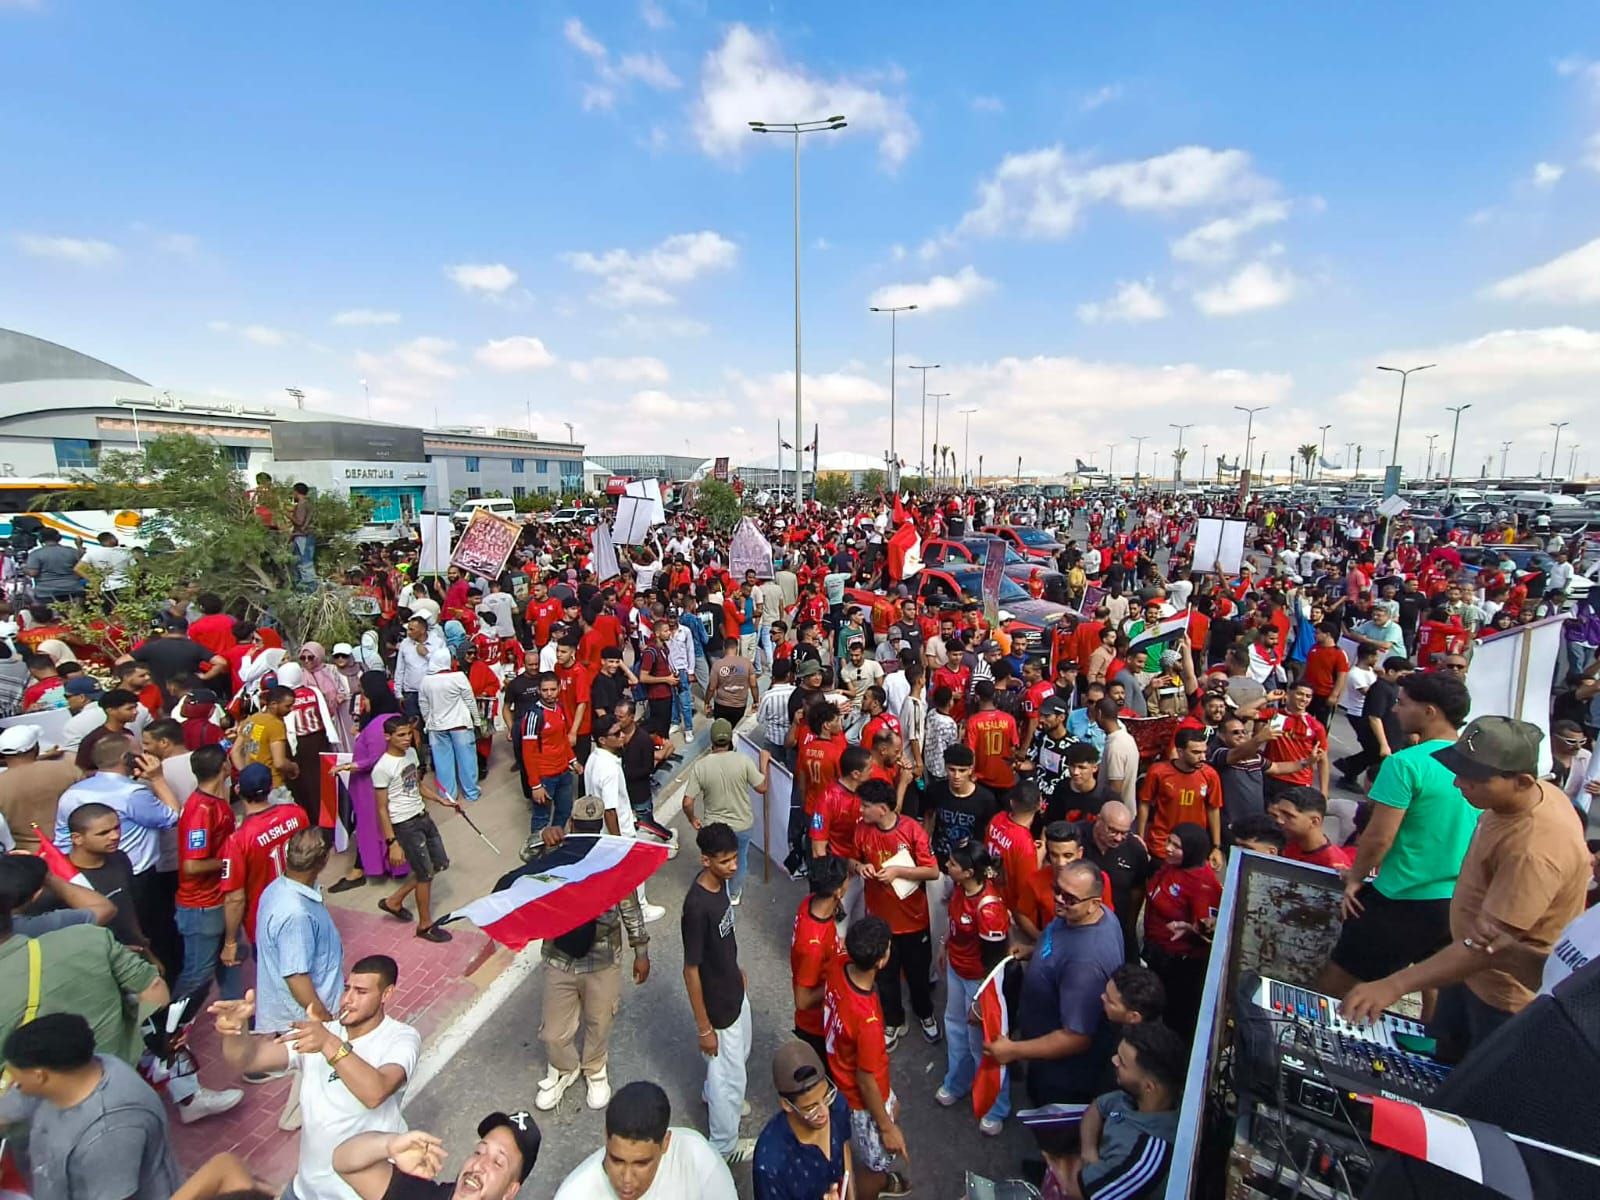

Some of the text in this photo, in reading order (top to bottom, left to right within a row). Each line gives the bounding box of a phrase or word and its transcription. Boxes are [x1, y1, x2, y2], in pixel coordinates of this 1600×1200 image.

[345, 468, 394, 479] DEPARTURE
[985, 731, 1003, 756] 10
[1180, 788, 1195, 806] 10
